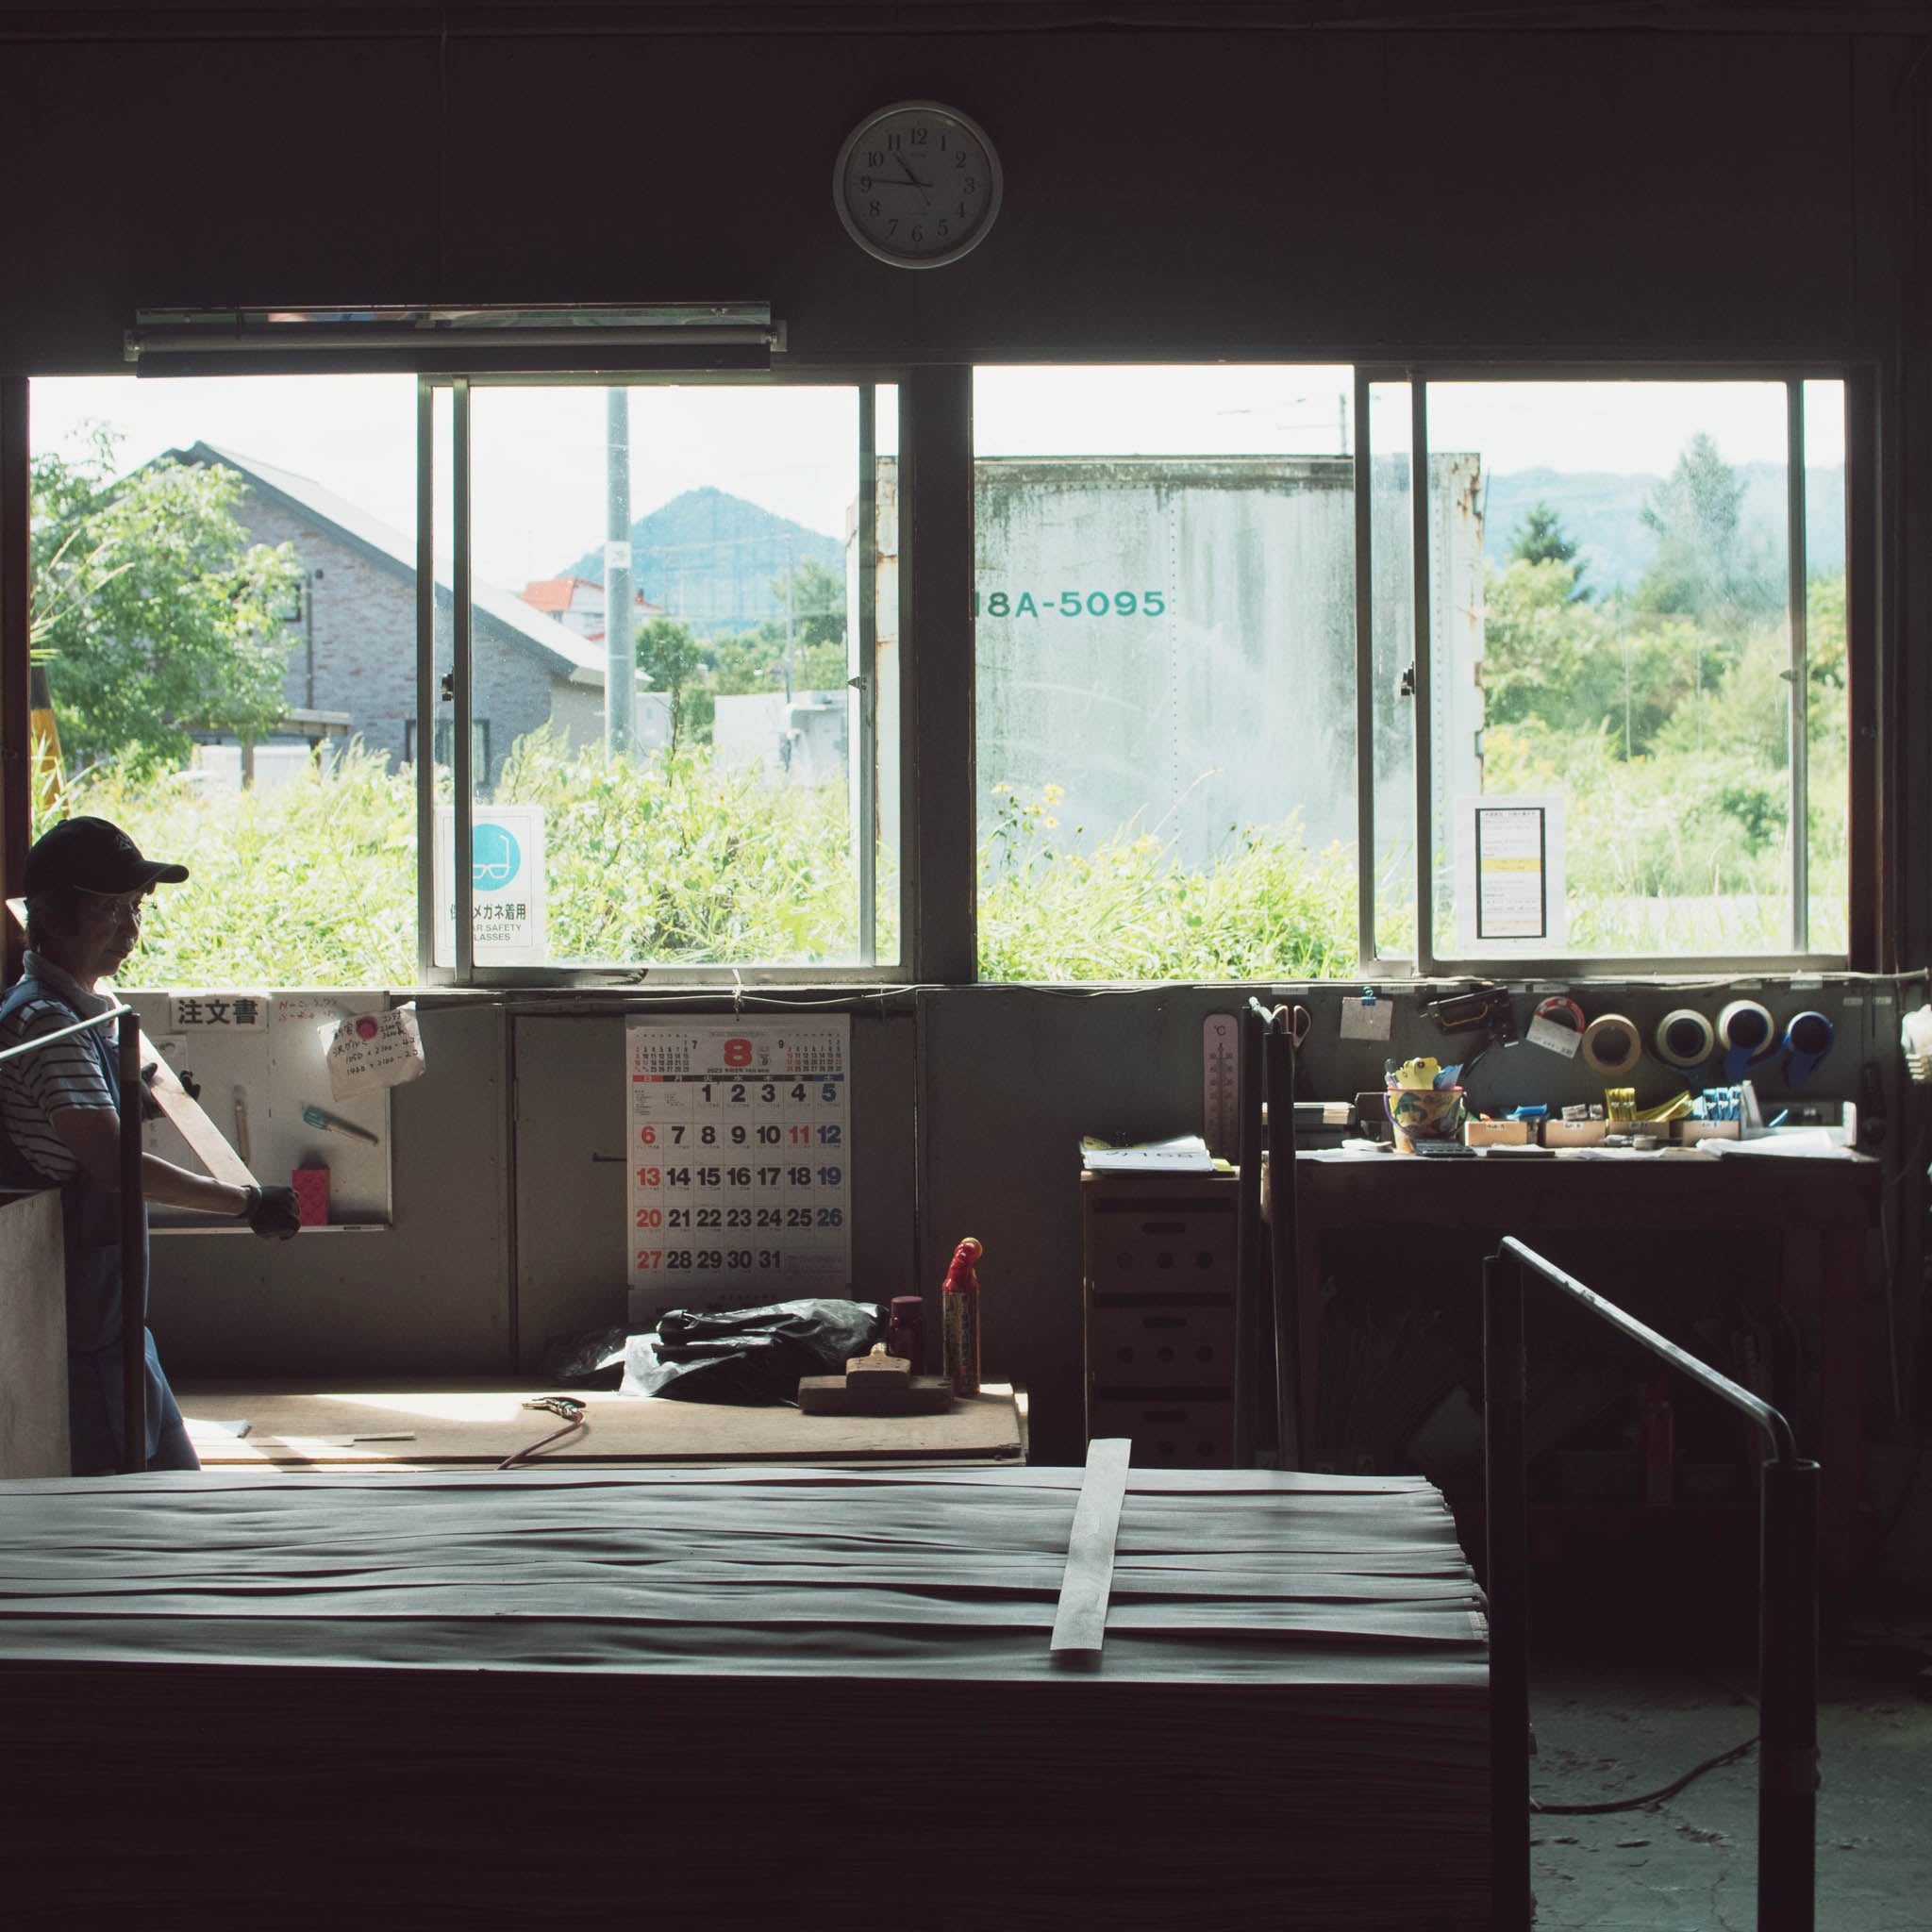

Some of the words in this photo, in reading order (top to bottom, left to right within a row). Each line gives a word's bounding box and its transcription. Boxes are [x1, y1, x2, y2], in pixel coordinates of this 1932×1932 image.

[888, 134, 901, 151] 11
[910, 128, 927, 144] 12
[941, 136, 946, 151] 1
[868, 151, 884, 167] 10
[956, 152, 966, 168] 2
[860, 176, 872, 192] 9
[964, 177, 974, 194] 3
[869, 201, 880, 216] 8
[956, 203, 966, 218] 4
[889, 219, 898, 235] 7
[911, 225, 923, 242] 6
[938, 219, 948, 236] 5
[450, 903, 525, 921] メガネ着用
[474, 933, 511, 941] LASSES
[177, 998, 258, 1024] 注文書
[691, 1041, 697, 1049] 7
[778, 1040, 784, 1048] 9
[724, 1039, 752, 1067] 8
[703, 1084, 710, 1102] 1
[732, 1084, 745, 1102] 2
[762, 1084, 775, 1102] 3
[791, 1084, 806, 1101] 4
[822, 1083, 836, 1102] 5
[641, 1126, 656, 1144] 6
[672, 1126, 685, 1143] 7
[702, 1126, 715, 1144] 8
[732, 1126, 745, 1144] 9
[758, 1125, 780, 1143] 10
[790, 1126, 808, 1143] 11
[818, 1125, 841, 1144] 12
[638, 1168, 660, 1186] 13
[667, 1168, 691, 1186] 14
[697, 1168, 721, 1186] 15
[727, 1168, 751, 1185] 16
[758, 1168, 781, 1185] 17
[788, 1167, 810, 1185] 18
[818, 1167, 841, 1185] 19
[637, 1209, 661, 1227] 20
[669, 1209, 690, 1227] 21
[697, 1209, 722, 1226] 22
[727, 1209, 751, 1227] 23
[758, 1209, 782, 1226] 24
[788, 1208, 812, 1226] 25
[817, 1208, 842, 1226] 26
[638, 1251, 661, 1269] 27
[667, 1251, 691, 1269] 28
[697, 1251, 723, 1269] 29
[728, 1251, 752, 1269] 30
[759, 1251, 780, 1269] 31
